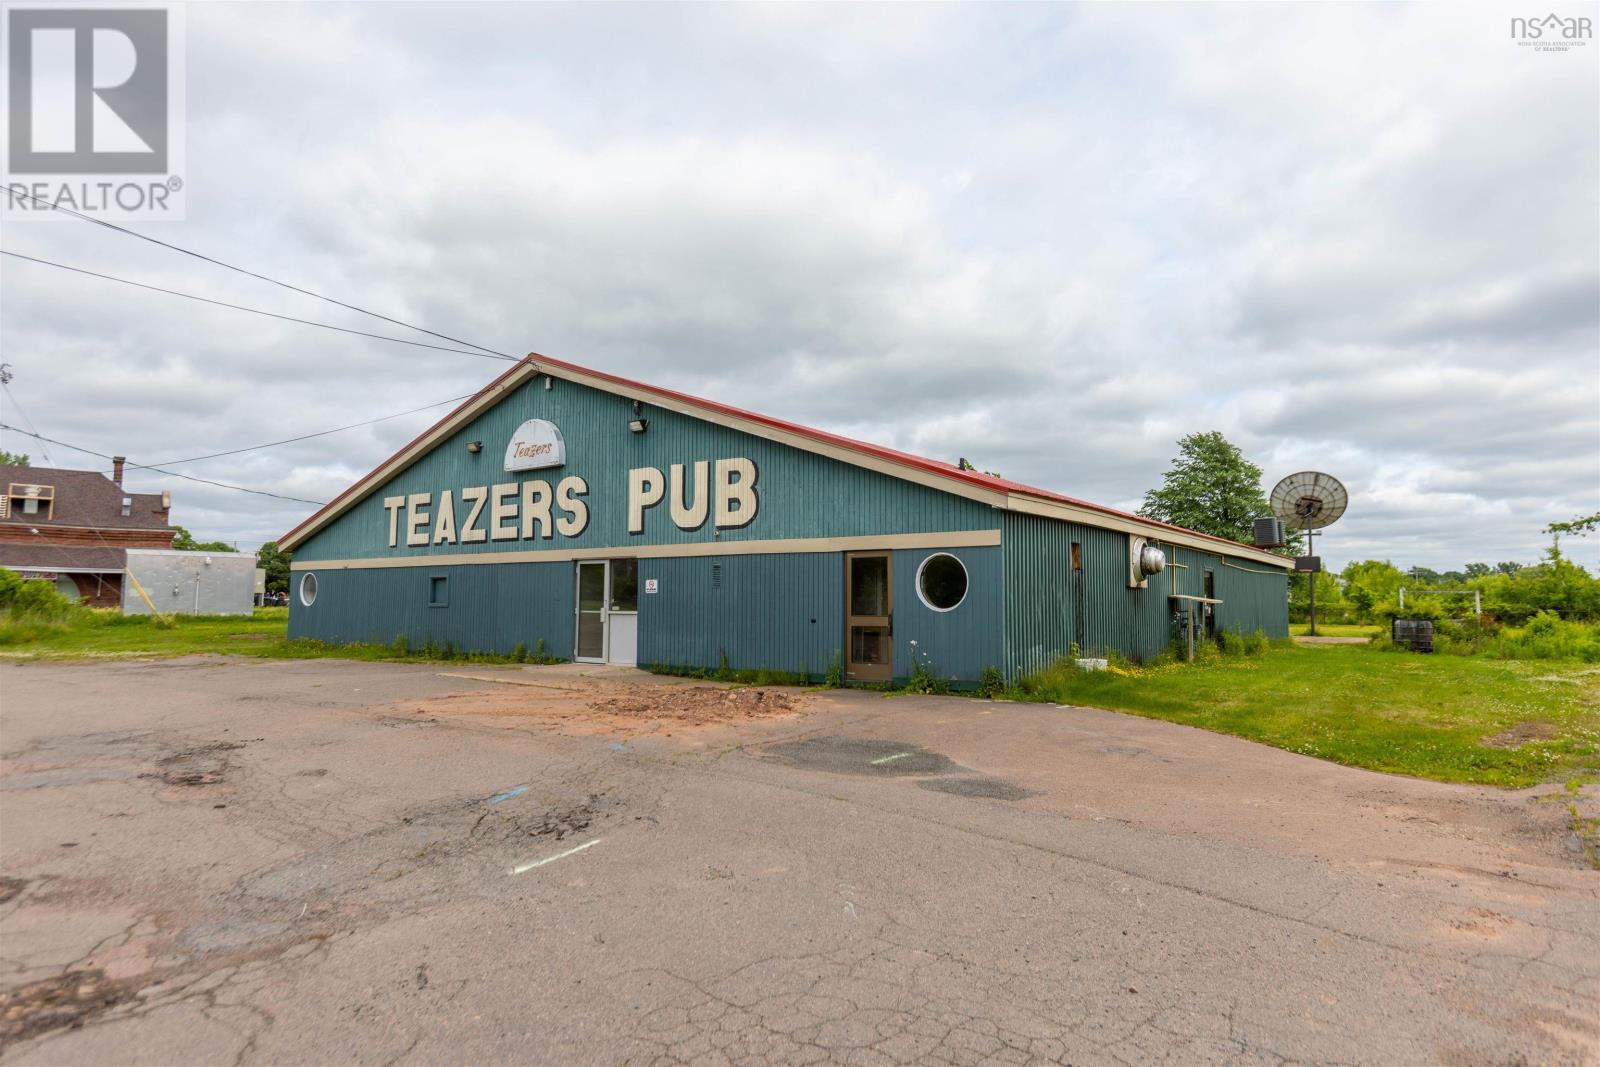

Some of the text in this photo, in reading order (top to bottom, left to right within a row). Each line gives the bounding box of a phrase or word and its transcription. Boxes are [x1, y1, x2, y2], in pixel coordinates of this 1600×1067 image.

[513, 441, 552, 458] Teazers
[384, 457, 760, 548] TEAZERS PUB
